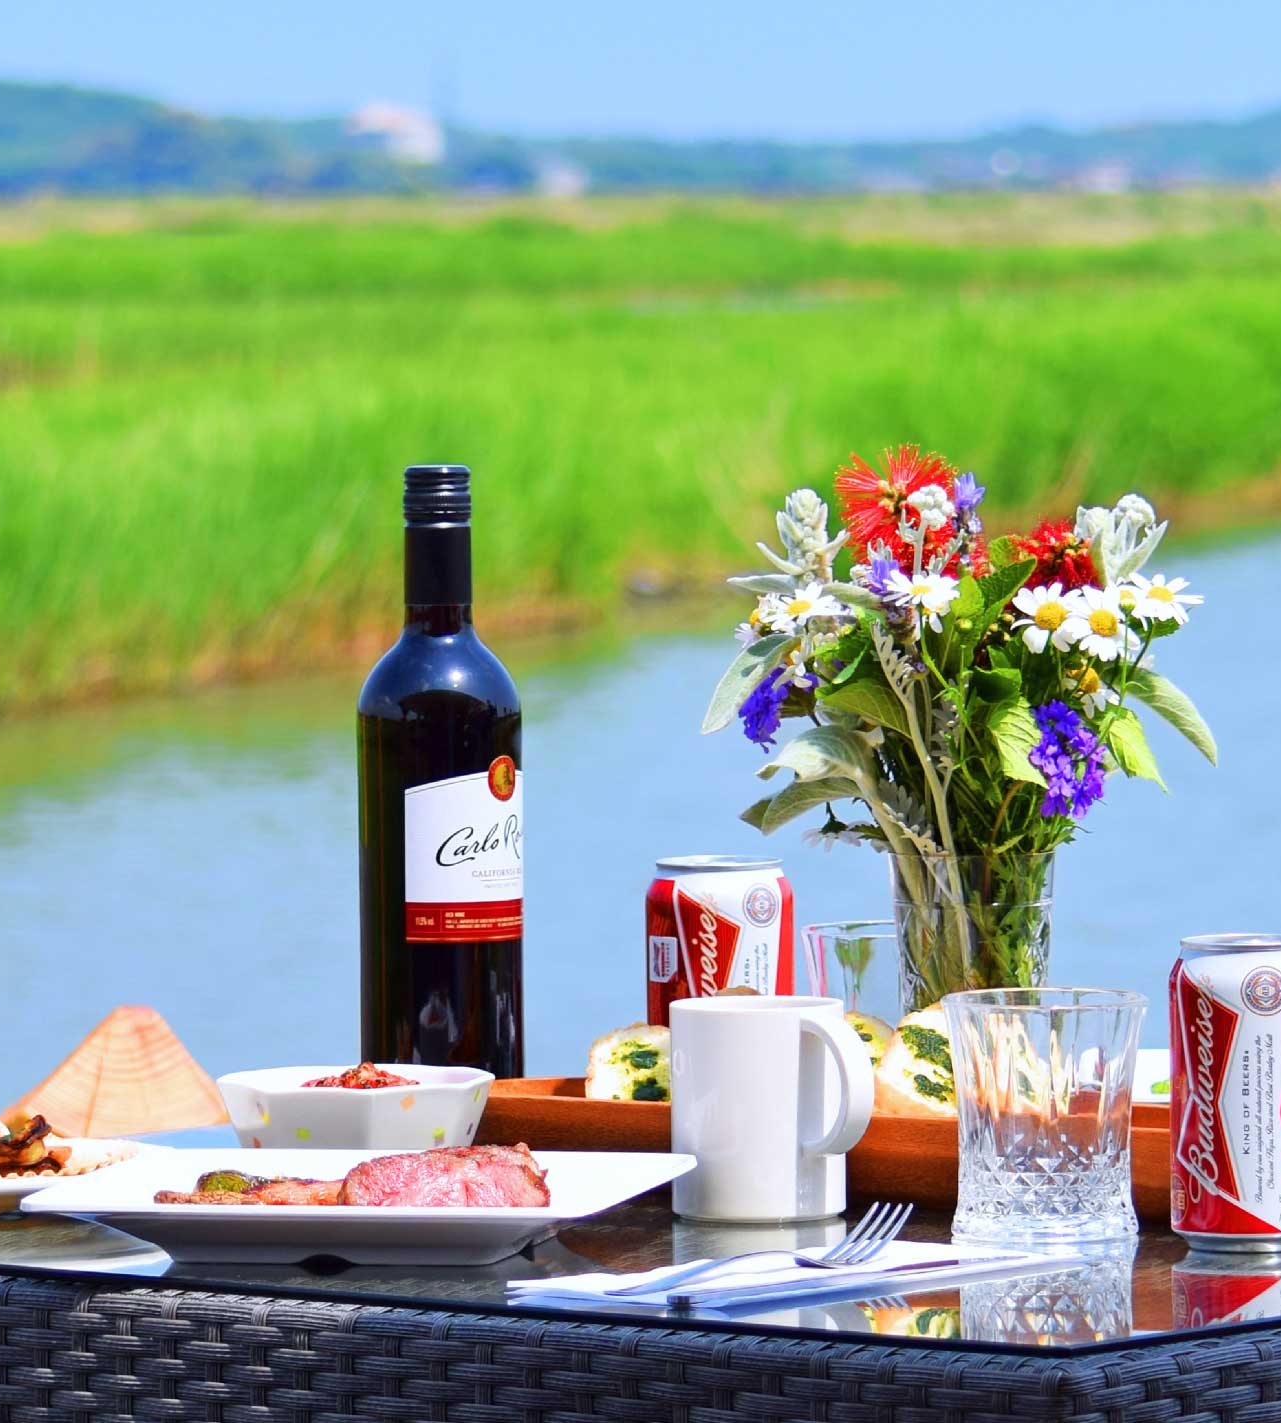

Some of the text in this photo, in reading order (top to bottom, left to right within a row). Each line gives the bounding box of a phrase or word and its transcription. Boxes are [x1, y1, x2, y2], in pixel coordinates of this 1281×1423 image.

[435, 823, 499, 867] Carlo
[1189, 975, 1219, 1204] Budweiser
[1243, 1103, 1250, 1119] OF
[1242, 1124, 1250, 1155] KING
